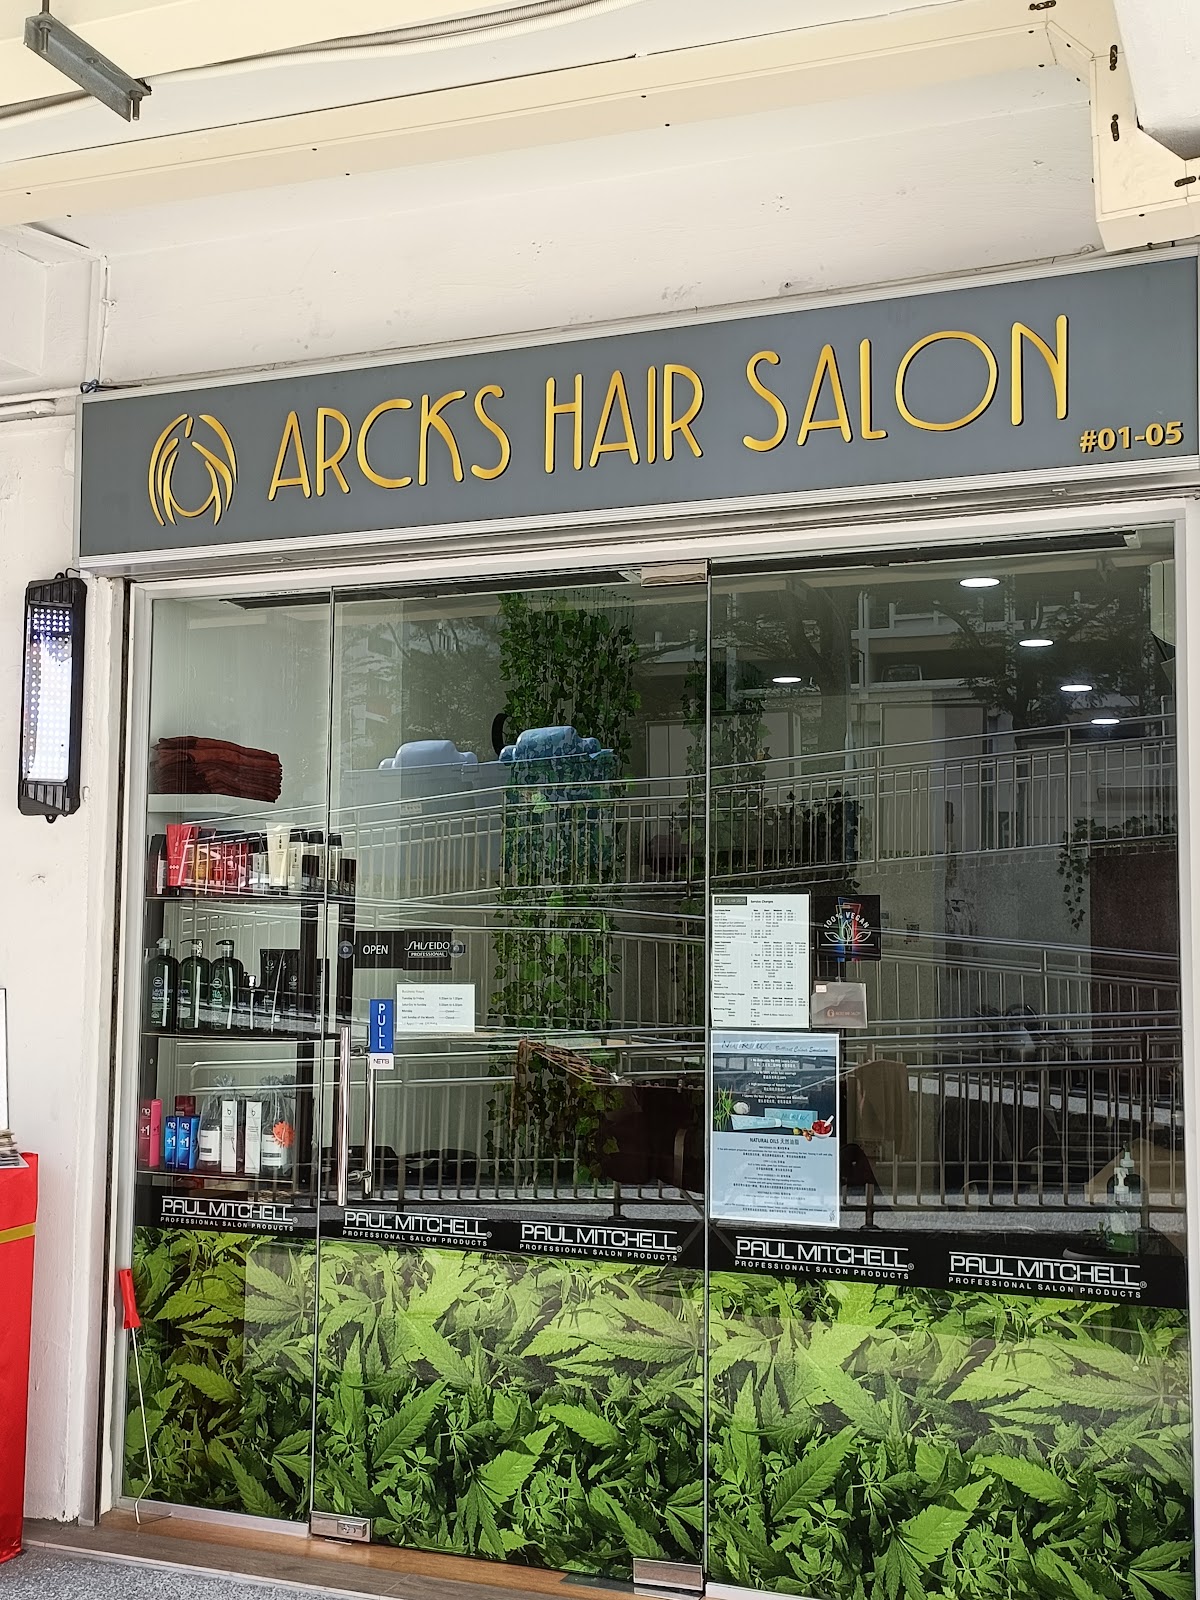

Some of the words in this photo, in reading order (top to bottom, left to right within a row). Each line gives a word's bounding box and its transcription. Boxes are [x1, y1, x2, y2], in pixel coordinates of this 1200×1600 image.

[268, 384, 511, 501] ARCKS
[545, 363, 704, 473] HAIR
[743, 314, 1068, 452] SALON
[1080, 420, 1183, 453] #01-05
[845, 911, 870, 928] VEGAN
[362, 944, 389, 955] OPEN
[404, 940, 450, 951] SHISEIDO
[378, 1003, 386, 1049] PULL
[167, 1136, 176, 1147] +1
[180, 1137, 189, 1147] +1
[162, 1199, 206, 1216] PAUL
[160, 1216, 219, 1227] PROFESSIONAL
[222, 1221, 248, 1229] SALON
[251, 1223, 294, 1232] PRODUCTS
[344, 1211, 392, 1229] PAUL
[342, 1230, 405, 1241] PROFESSIONAL
[409, 1234, 437, 1243] SALON
[441, 1237, 487, 1247] PRODUCTS
[521, 1224, 573, 1242] PAUL
[519, 1243, 588, 1255] PROFESSIONAL
[592, 1248, 622, 1258] SALON
[627, 1251, 678, 1262] PRODUCTS
[736, 1239, 794, 1259] PAUL
[734, 1260, 810, 1272] PROFESSIONAL
[815, 1265, 849, 1275] SALON
[853, 1269, 909, 1280] PRODUCTS
[950, 1255, 1014, 1276] PAUL
[948, 1276, 1032, 1290] PROFESSIONAL
[1037, 1283, 1074, 1293] SALON
[1079, 1286, 1141, 1299] PRODUCTS
